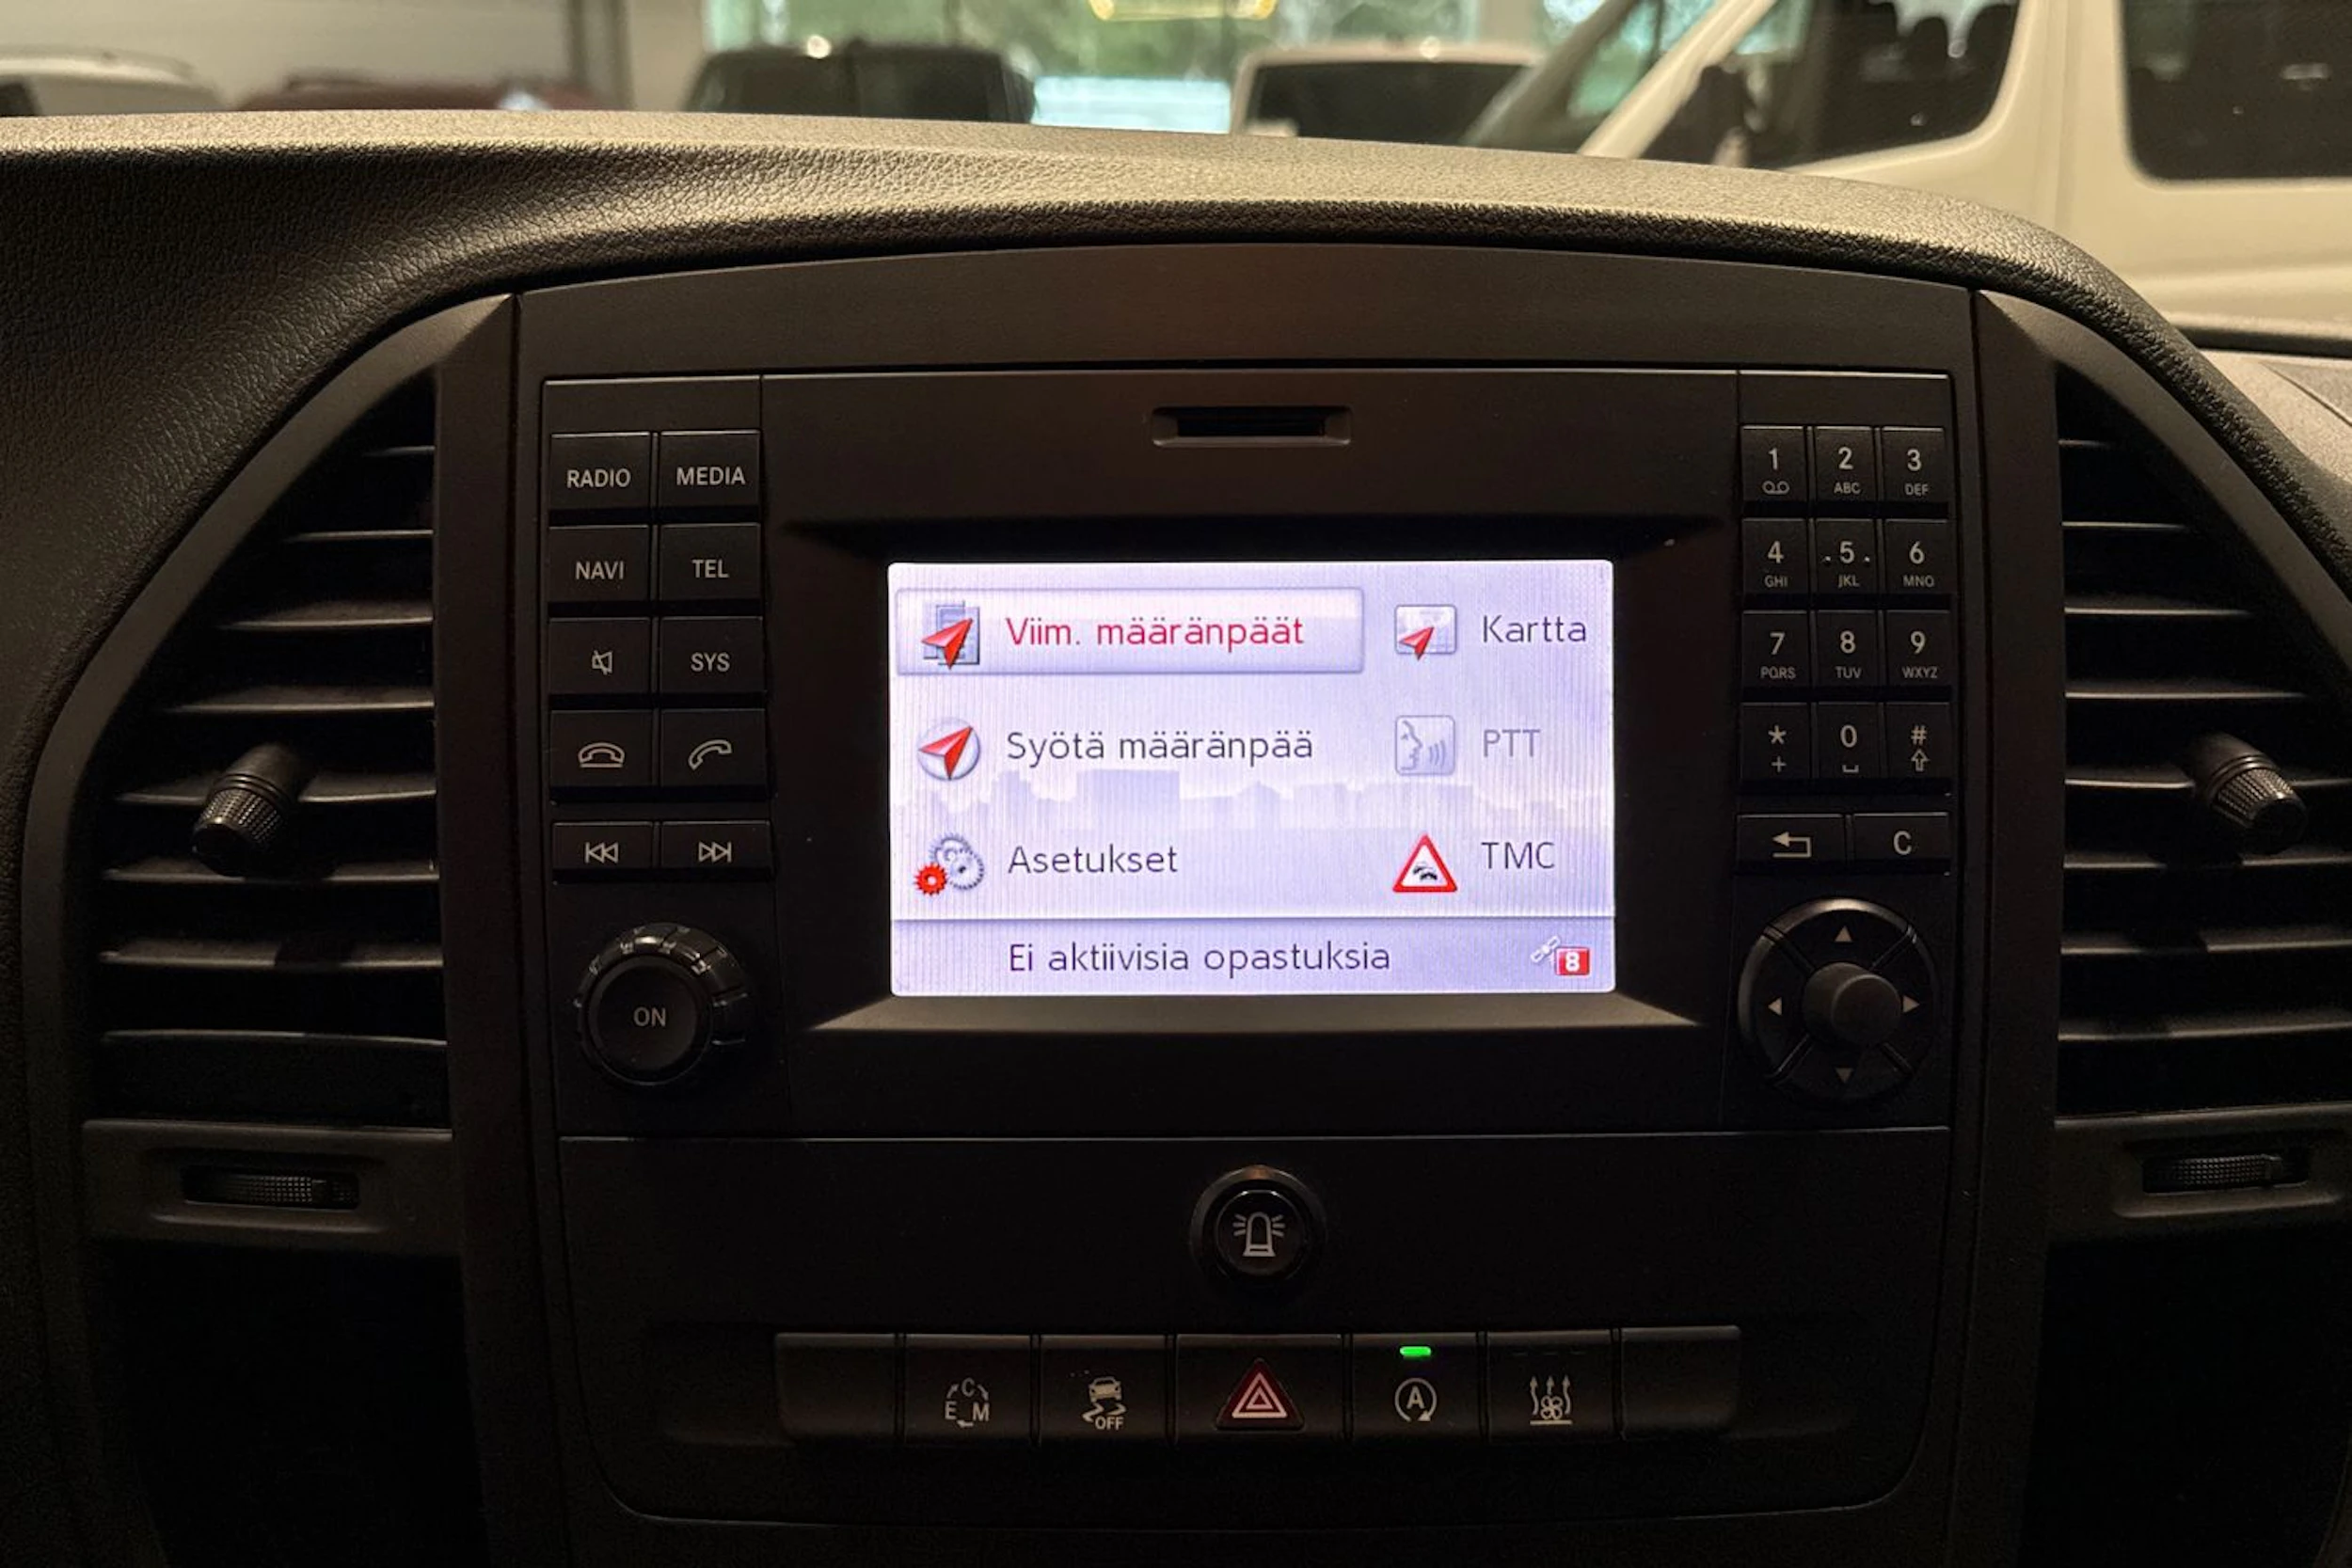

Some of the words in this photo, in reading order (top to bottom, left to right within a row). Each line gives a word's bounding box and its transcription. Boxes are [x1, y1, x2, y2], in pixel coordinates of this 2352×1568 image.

[1768, 447, 1779, 470] 1
[1837, 447, 1854, 470] 2
[1906, 448, 1923, 472] 3
[566, 468, 631, 488] RADIO
[675, 467, 746, 486] MEDIA
[1834, 482, 1862, 495] ABC
[1904, 483, 1930, 497] DEF
[1767, 540, 1785, 564] 4
[1908, 540, 1926, 564] 6
[575, 561, 625, 580] NAVI
[691, 560, 730, 578] TEL
[1764, 575, 1788, 588] GHI
[1837, 575, 1860, 588] JKL
[1902, 575, 1935, 588] MNO
[1005, 616, 1081, 646] Viim.
[1096, 616, 1305, 654] määränpäät
[1483, 614, 1587, 643] Kartta
[1769, 631, 1786, 656] 7
[1839, 630, 1857, 654] 8
[1910, 630, 1927, 654] 9
[690, 653, 730, 673] SYS
[1760, 666, 1796, 680] PQRS
[1836, 666, 1863, 679] TUV
[1901, 666, 1939, 679] WXYZ
[1483, 729, 1541, 757] PTT
[1839, 724, 1858, 748] 0
[1007, 730, 1106, 769] Syötä
[1119, 730, 1313, 768] määränpää
[1893, 830, 1913, 856] C
[1008, 845, 1179, 874] Asetukset
[1481, 841, 1556, 870] TMC
[1009, 943, 1034, 973] Ei
[1047, 942, 1191, 972] aktiivisia
[1203, 941, 1391, 979] opastuksia
[1565, 950, 1581, 973] 8
[633, 1006, 667, 1027] ON
[961, 1377, 976, 1397] C
[1406, 1386, 1425, 1410] A
[944, 1401, 958, 1421] E
[972, 1402, 990, 1422] M
[1094, 1416, 1124, 1431] OFF
